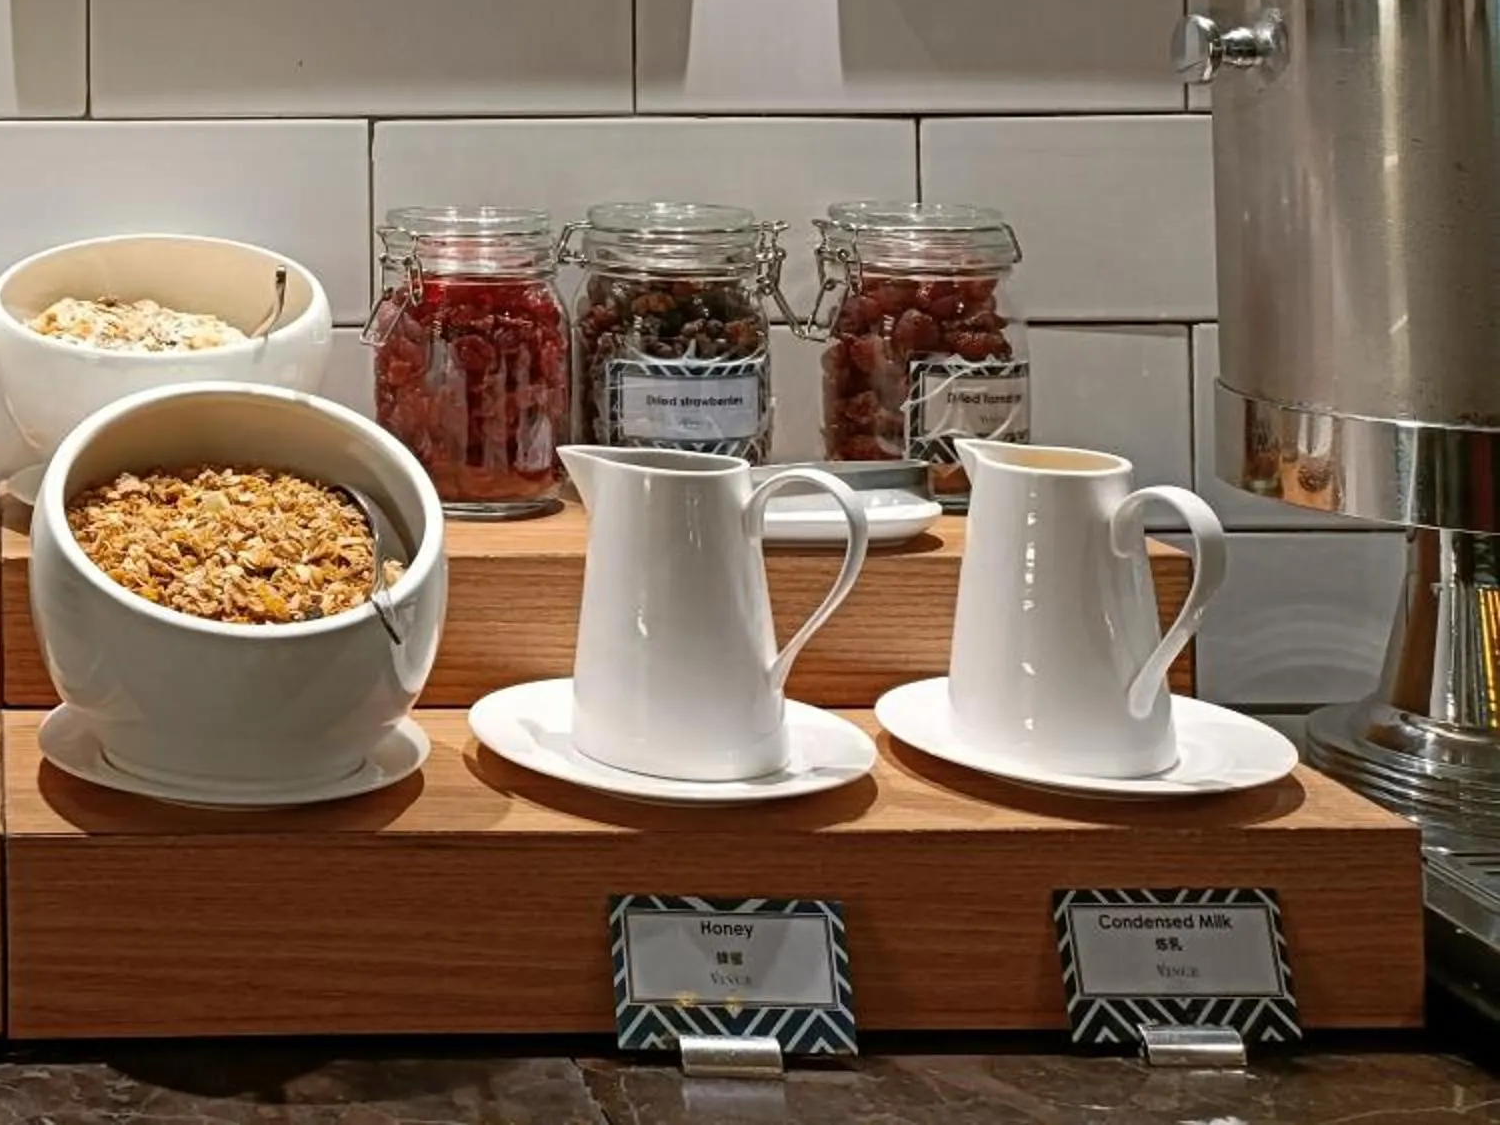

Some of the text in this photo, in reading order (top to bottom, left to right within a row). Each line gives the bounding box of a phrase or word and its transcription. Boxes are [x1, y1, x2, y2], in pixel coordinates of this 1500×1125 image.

[700, 920, 754, 939] Honey
[1098, 914, 1234, 930] Condensed Milk
